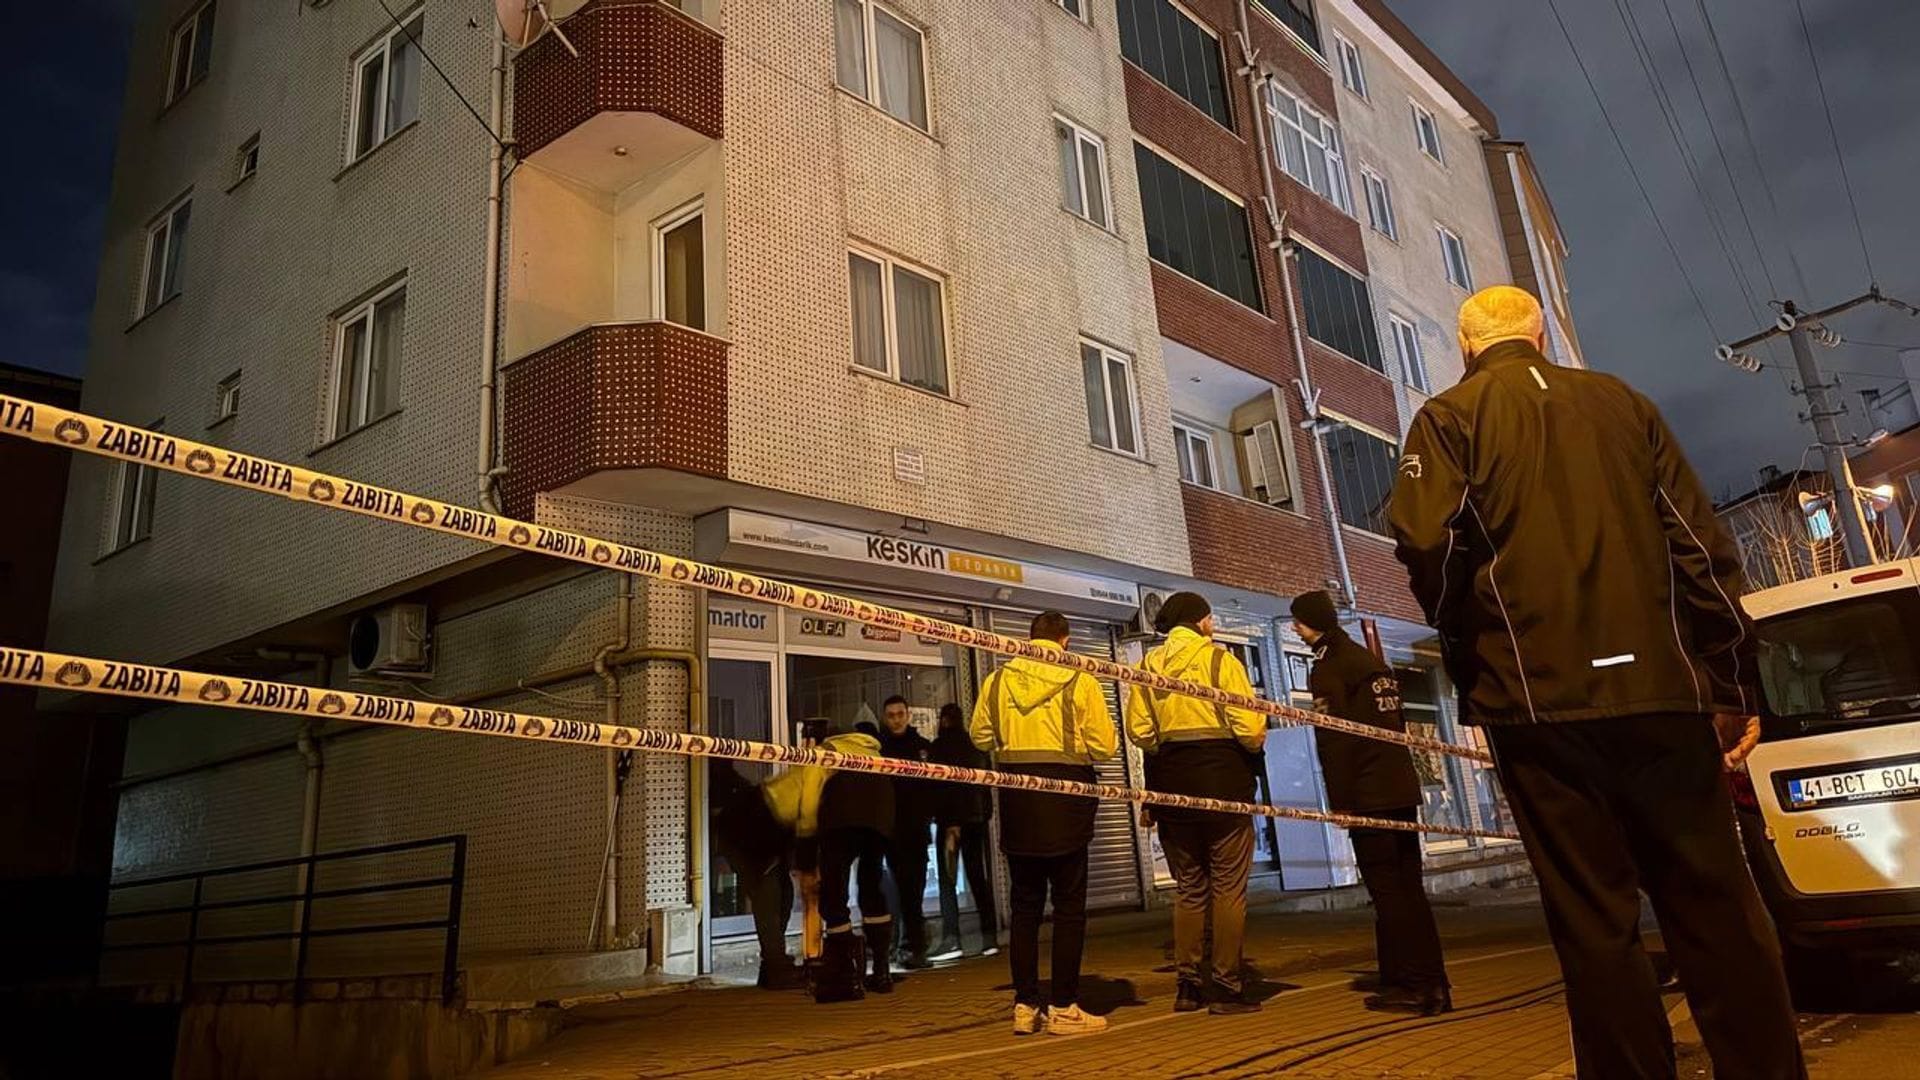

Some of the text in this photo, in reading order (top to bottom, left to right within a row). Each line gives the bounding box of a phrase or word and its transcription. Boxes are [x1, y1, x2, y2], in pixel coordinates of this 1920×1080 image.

[96, 424, 176, 465] ZABITA
[223, 455, 293, 492] ZABITA
[342, 483, 404, 517] ZABITA
[440, 506, 496, 538] ZABITA
[535, 528, 586, 558] ZABITA
[616, 547, 662, 574] ZABITA
[693, 565, 733, 590] ZABITA
[757, 580, 795, 603] ZABITA
[820, 594, 855, 617] ZABITA
[708, 608, 767, 630] martor
[802, 619, 845, 637] OLFA
[100, 664, 181, 696] ZABITA
[236, 681, 310, 711] ZABITA
[351, 695, 415, 722] ZABITA
[458, 709, 516, 734] ZABITA
[550, 720, 601, 742] ZABITA
[635, 729, 682, 750] ZABITA
[709, 737, 750, 758] ZABITA
[1804, 779, 1824, 798] 41
[1832, 773, 1866, 795] BCT
[1881, 768, 1919, 789] 604
